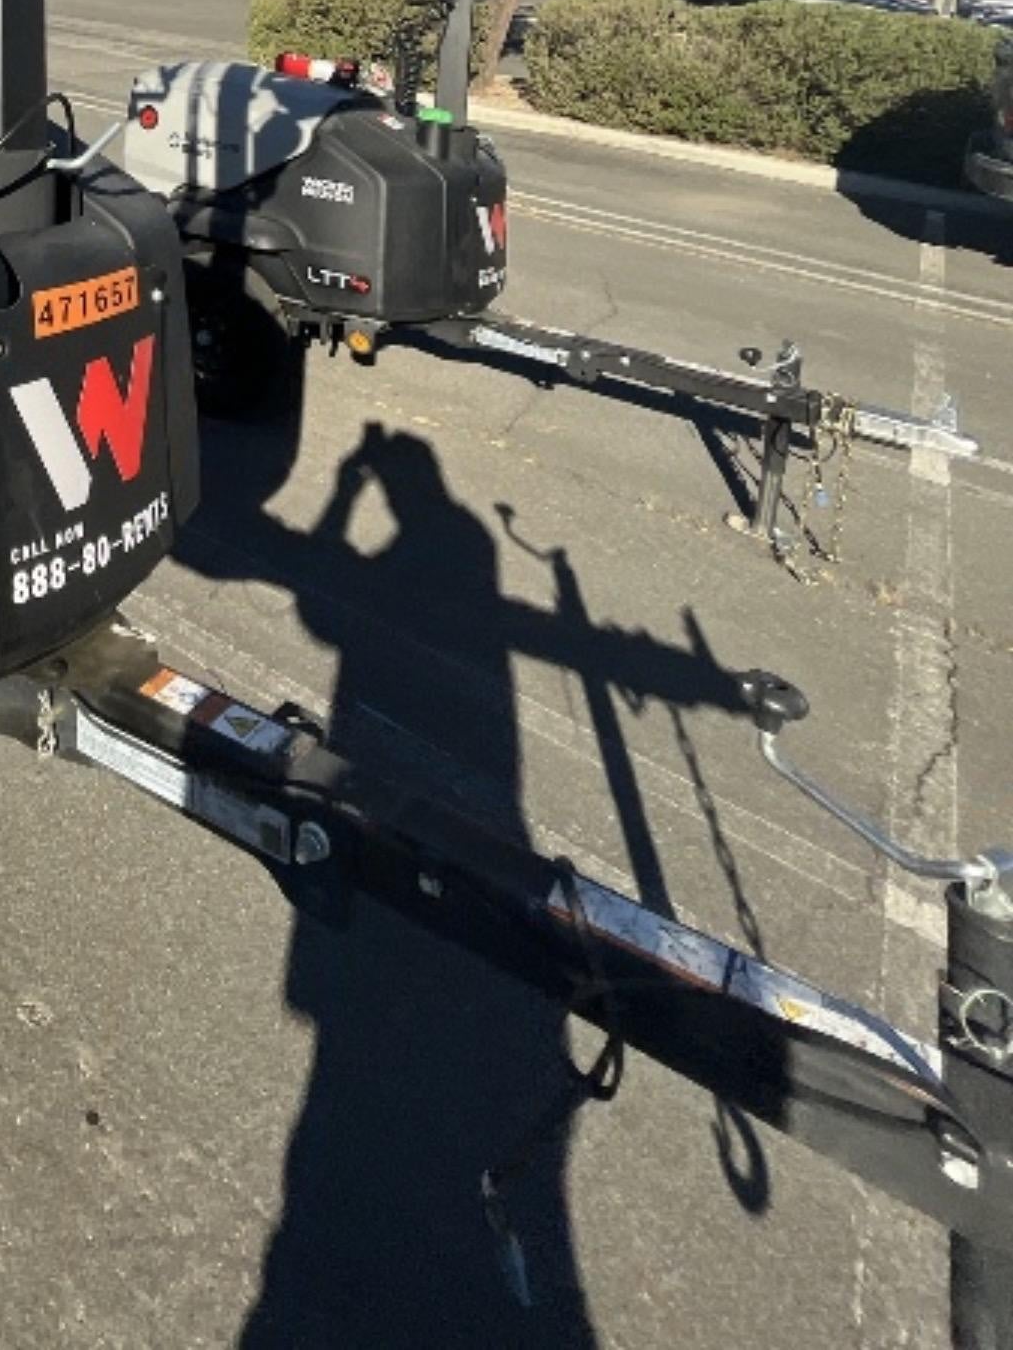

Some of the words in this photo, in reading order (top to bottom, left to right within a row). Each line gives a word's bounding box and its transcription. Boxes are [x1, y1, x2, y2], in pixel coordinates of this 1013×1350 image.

[37, 275, 137, 327] 471657
[10, 538, 49, 565] CALL
[55, 521, 85, 550] NOW
[12, 492, 170, 605] 888-80-RENTS
